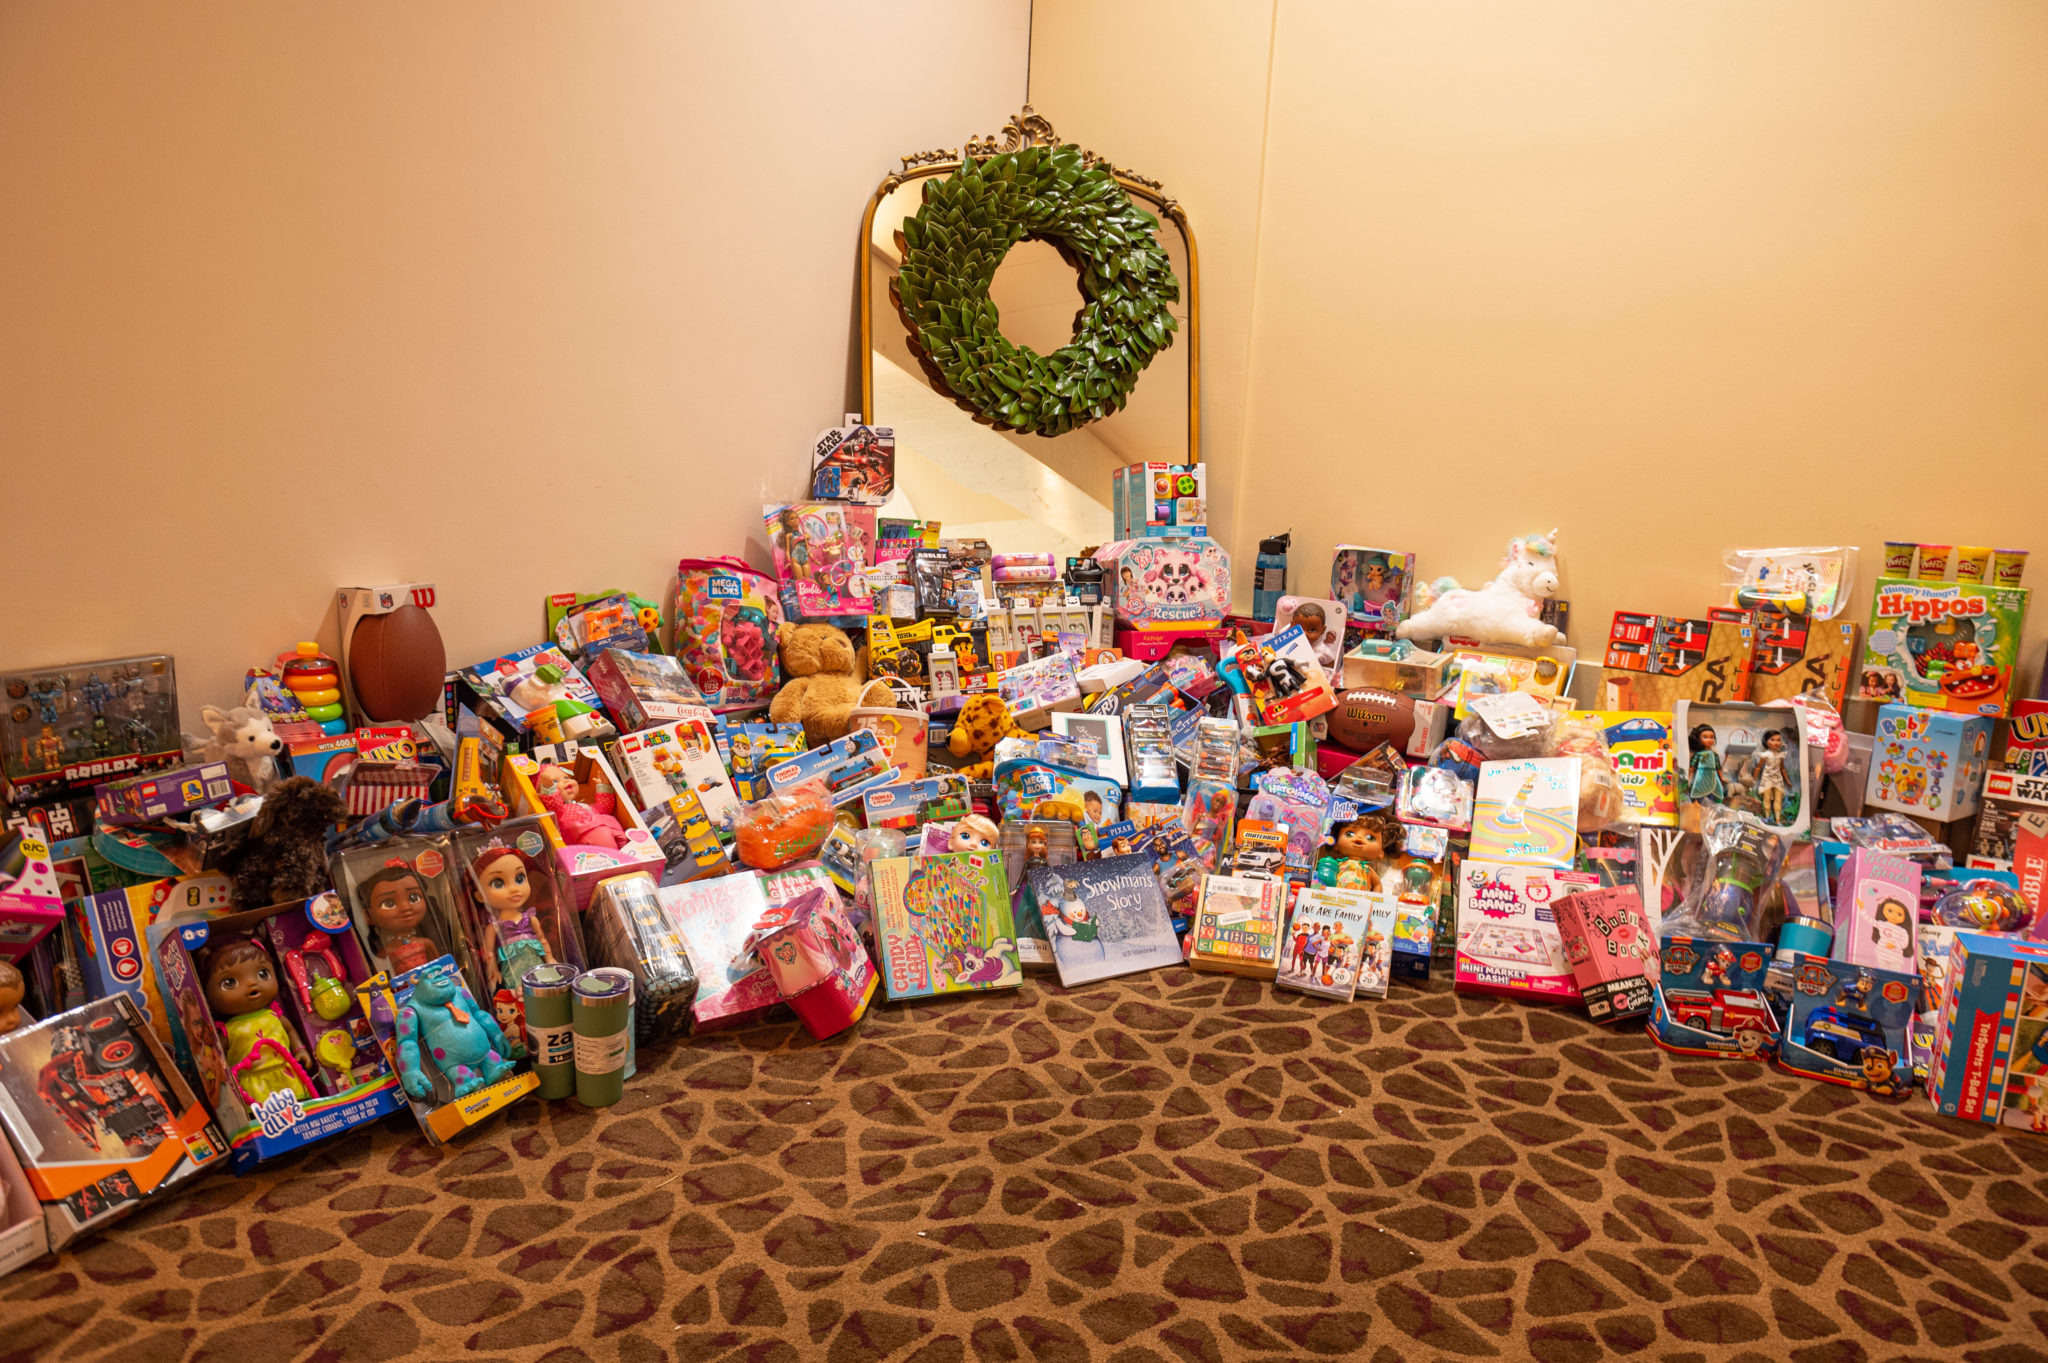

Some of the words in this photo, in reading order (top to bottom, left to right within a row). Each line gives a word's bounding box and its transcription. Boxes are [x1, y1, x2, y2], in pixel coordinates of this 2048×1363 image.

[817, 430, 842, 449] STAR
[817, 434, 844, 457] WARS
[711, 580, 738, 588] MEGA
[712, 587, 740, 595] BLOKS
[798, 582, 823, 595] Barbie
[410, 587, 436, 608] W
[1884, 586, 1920, 597] Hungry
[1922, 588, 1959, 599] Hungry
[1153, 606, 1202, 619] Rescue?
[1880, 593, 1984, 622] Hippos
[1273, 628, 1300, 645] PIXAR
[516, 645, 546, 658] PIXAR
[1347, 707, 1387, 721] Wilson
[643, 729, 665, 740] SUPER
[643, 735, 672, 748] MARIO
[318, 742, 334, 751] WITH
[335, 739, 350, 749] 400
[361, 738, 417, 760] UNO
[65, 757, 139, 781] ROBLOX
[813, 755, 840, 769] THOMAS
[775, 765, 799, 778] THOMAS
[1990, 779, 2012, 790] LEGO
[2017, 779, 2048, 791] STA
[870, 793, 893, 801] THOMAS
[909, 792, 928, 800] PERCY
[1334, 800, 1358, 811] baby
[1110, 824, 1133, 836] PIXAR
[1245, 832, 1281, 841] MATCHBOX
[22, 843, 46, 853] R/C
[1863, 851, 1916, 873] Glitter
[782, 874, 811, 888] That
[1869, 864, 1910, 884] Girls
[1082, 873, 1153, 899] Snowman's
[1106, 893, 1142, 912] Story
[1470, 898, 1526, 914] BRANDS!
[1302, 904, 1314, 914] WE
[1316, 906, 1332, 917] ARE
[1334, 908, 1363, 922] FAMILY
[904, 938, 922, 984] LAND
[1661, 948, 1701, 962] PAW
[887, 934, 909, 993] CANDY
[1461, 963, 1483, 973] MINI
[1486, 966, 1526, 979] MARKET
[1793, 966, 1837, 983] PAW
[1478, 973, 1509, 985] DASH!
[1510, 980, 1529, 988] GAME
[256, 1089, 295, 1122] baby
[1965, 1098, 1977, 1114] Set
[263, 1105, 305, 1137] alive
